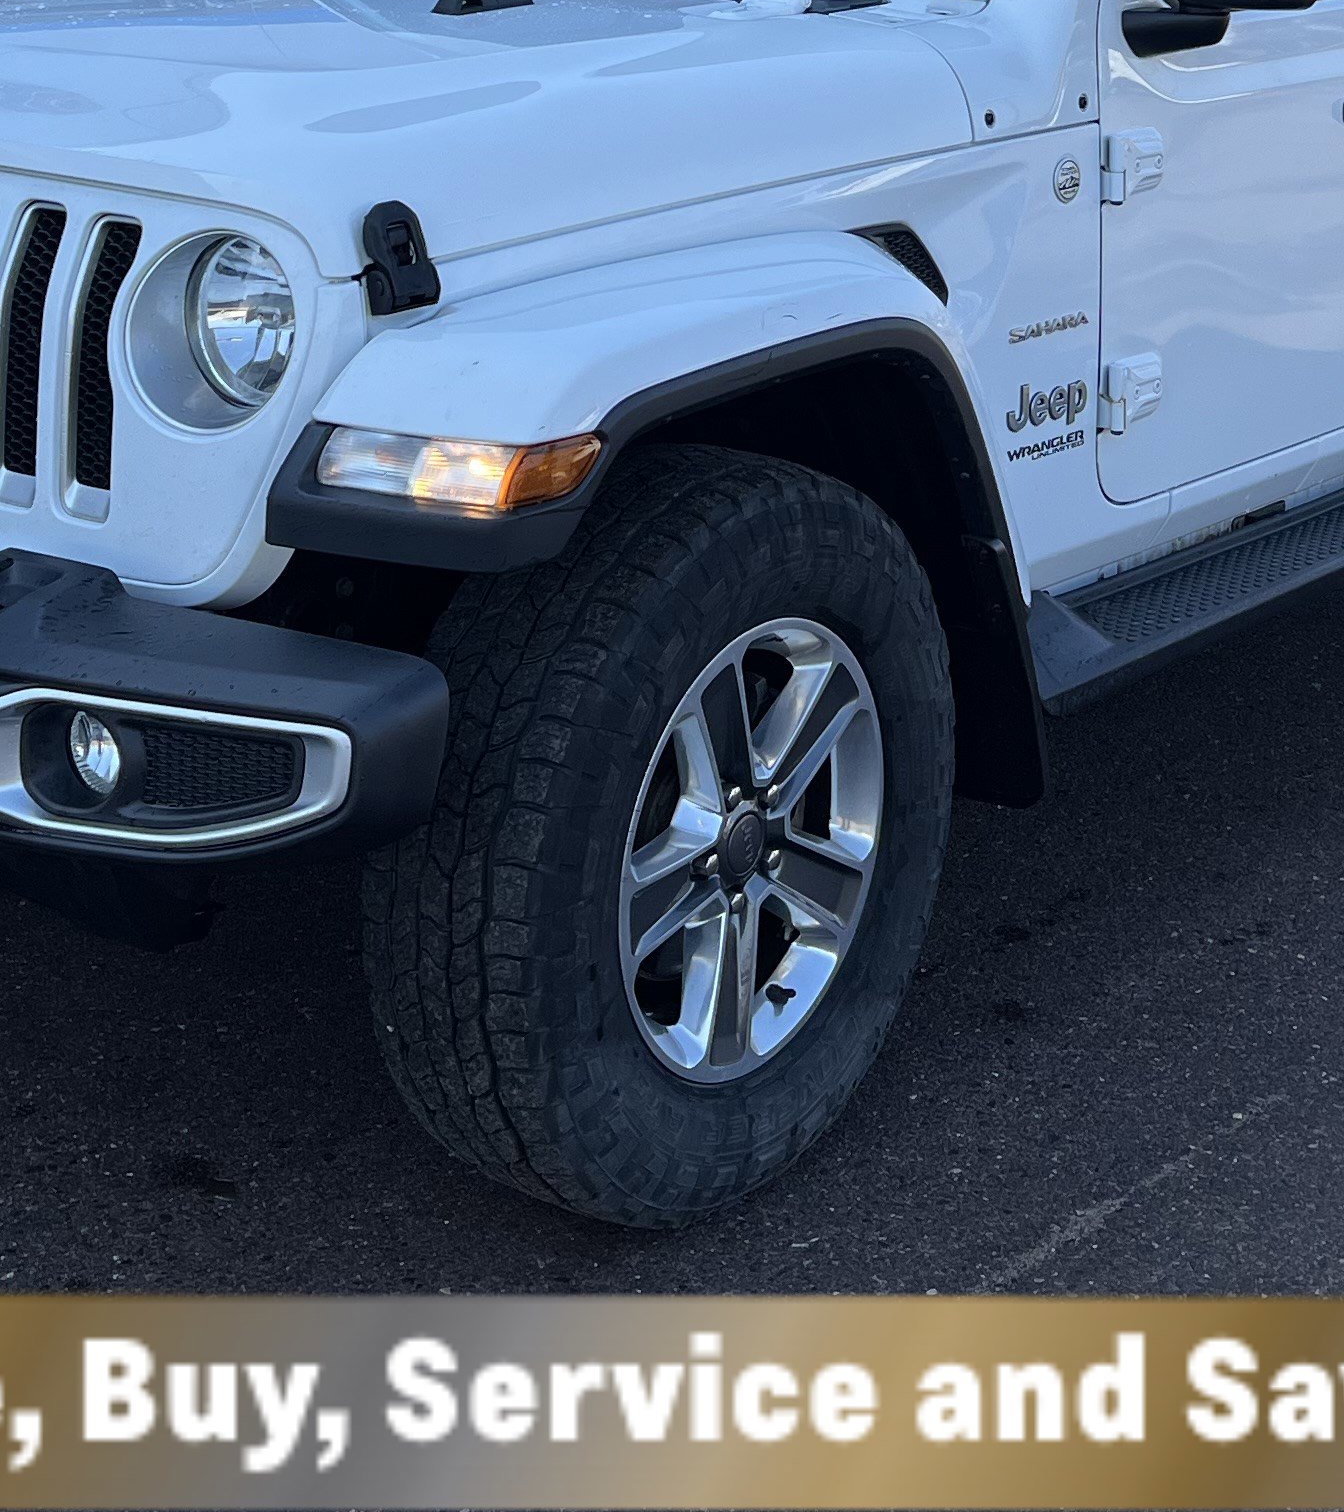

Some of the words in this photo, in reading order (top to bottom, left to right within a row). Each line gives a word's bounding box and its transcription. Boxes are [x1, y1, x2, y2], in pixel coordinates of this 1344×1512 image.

[1008, 311, 1089, 345] SAHARA
[1006, 379, 1088, 433] Jeep
[1006, 429, 1085, 462] WRANGLER
[1031, 440, 1085, 461] UNLIMITED
